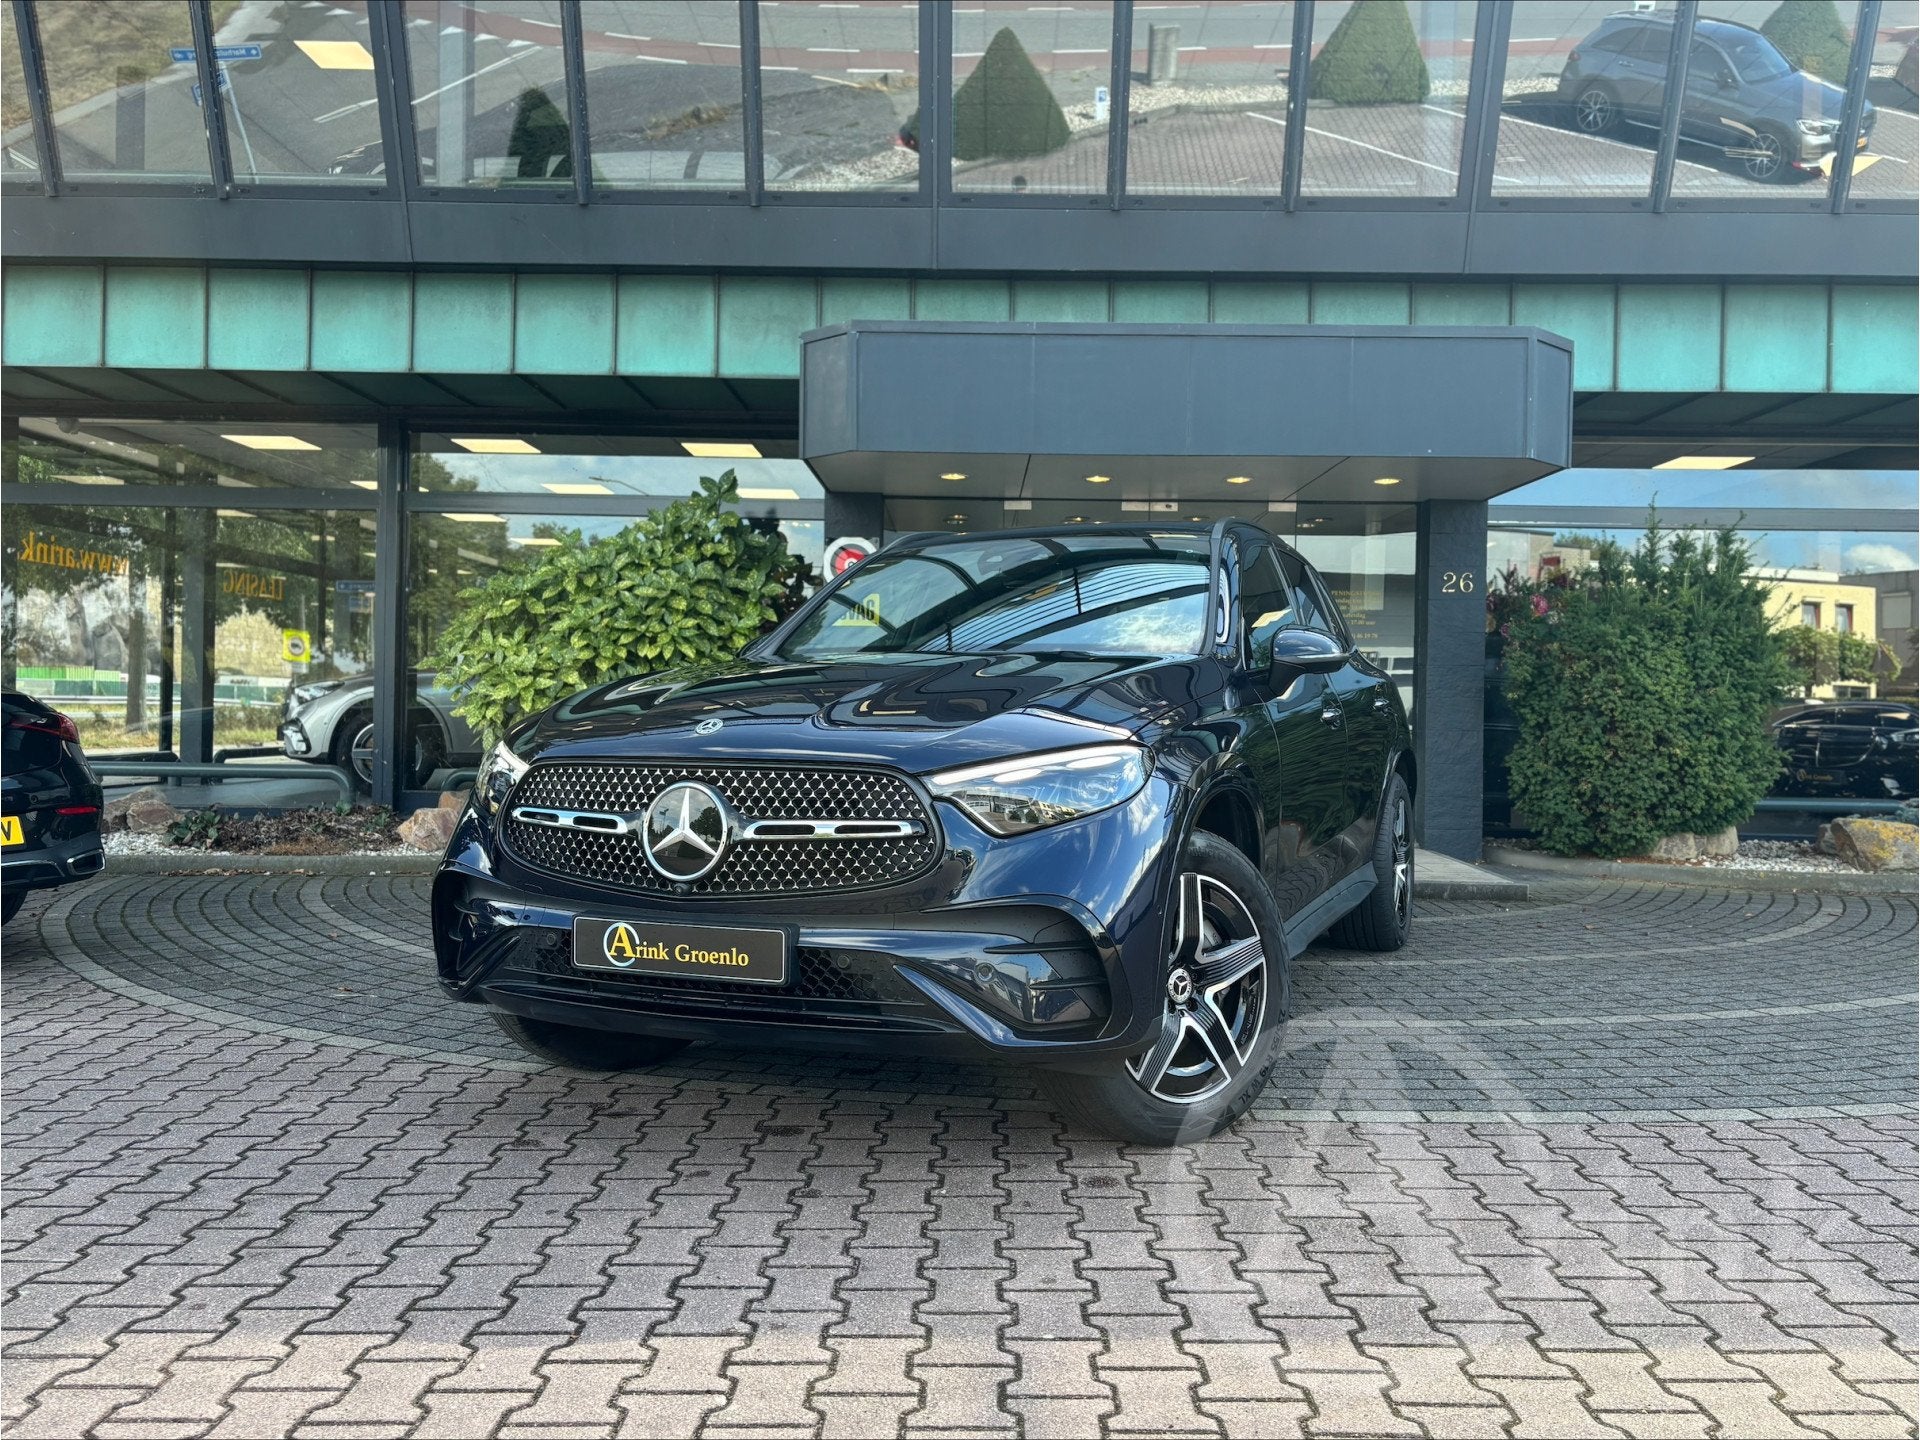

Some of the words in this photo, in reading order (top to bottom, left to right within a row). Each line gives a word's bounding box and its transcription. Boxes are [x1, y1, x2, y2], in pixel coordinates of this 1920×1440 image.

[1442, 571, 1474, 593] 26
[608, 924, 669, 961] Arink
[674, 944, 749, 967] Groenlo
